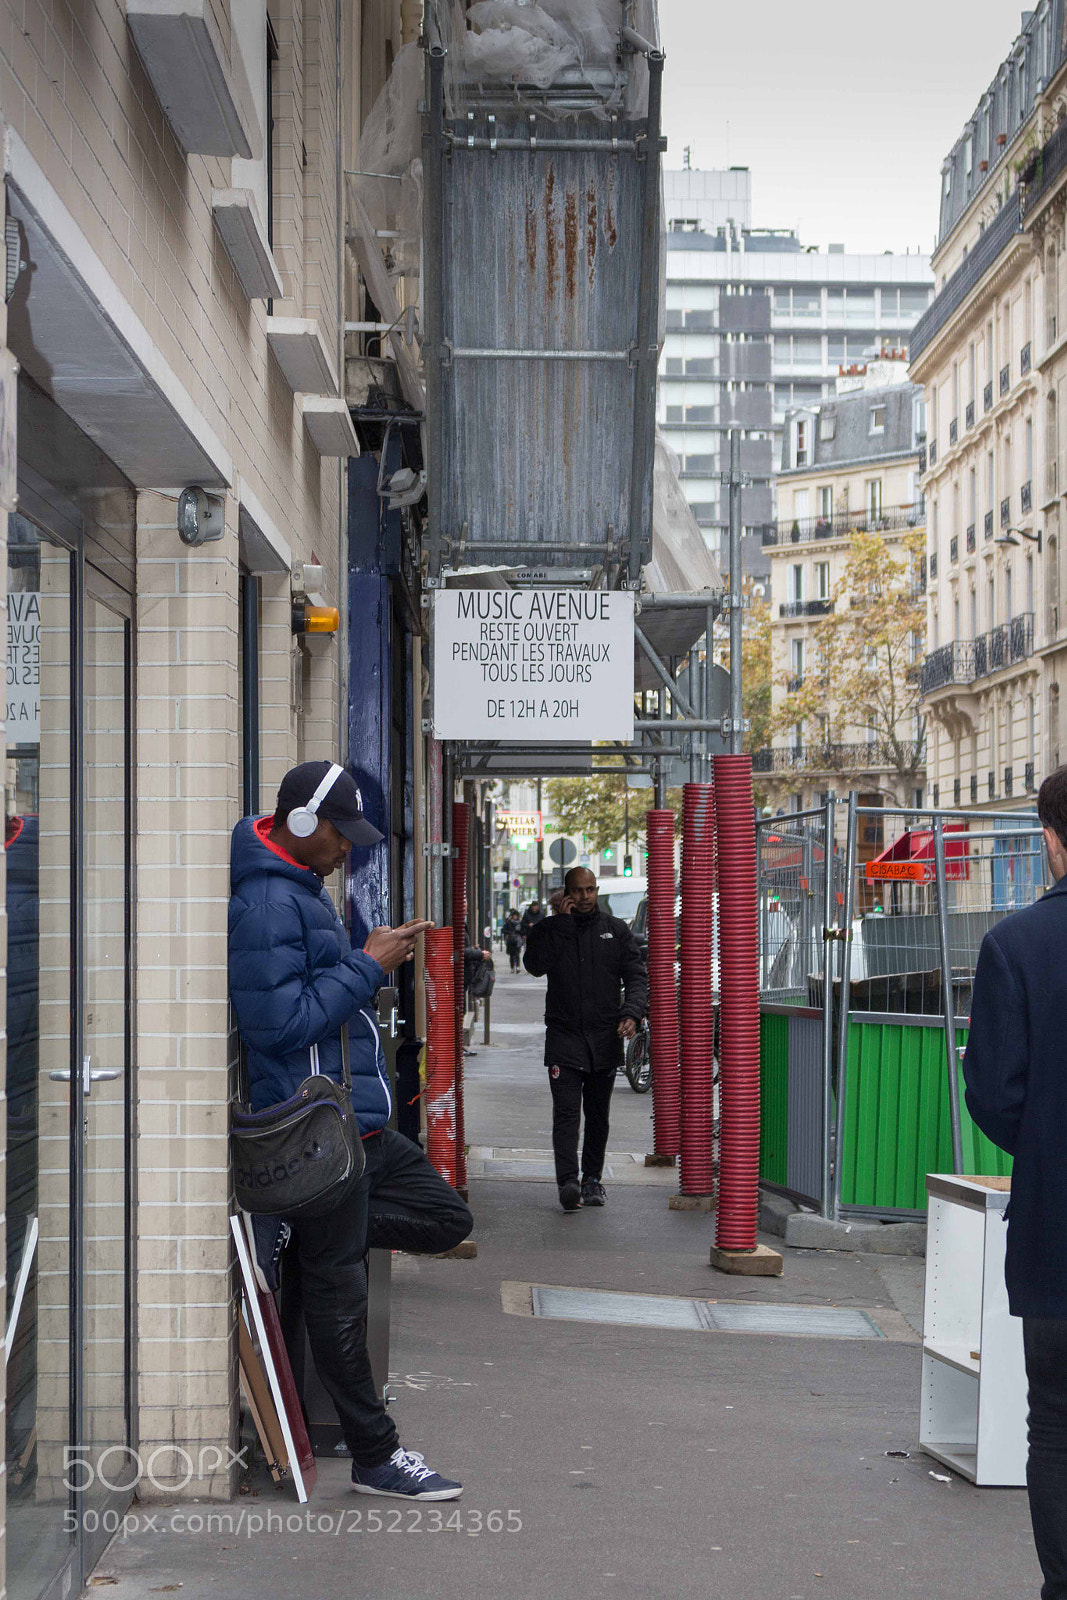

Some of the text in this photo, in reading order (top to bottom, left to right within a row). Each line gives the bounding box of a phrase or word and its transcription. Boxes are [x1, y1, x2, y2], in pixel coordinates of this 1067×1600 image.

[457, 592, 610, 620] MUSIC AVENUE
[480, 622, 579, 641] RESTE OUVERT
[452, 642, 610, 662] PENDANT LES TRAVAUX
[481, 663, 592, 683] TOUS LES JOURS
[487, 699, 579, 718] DE 12H A 20H
